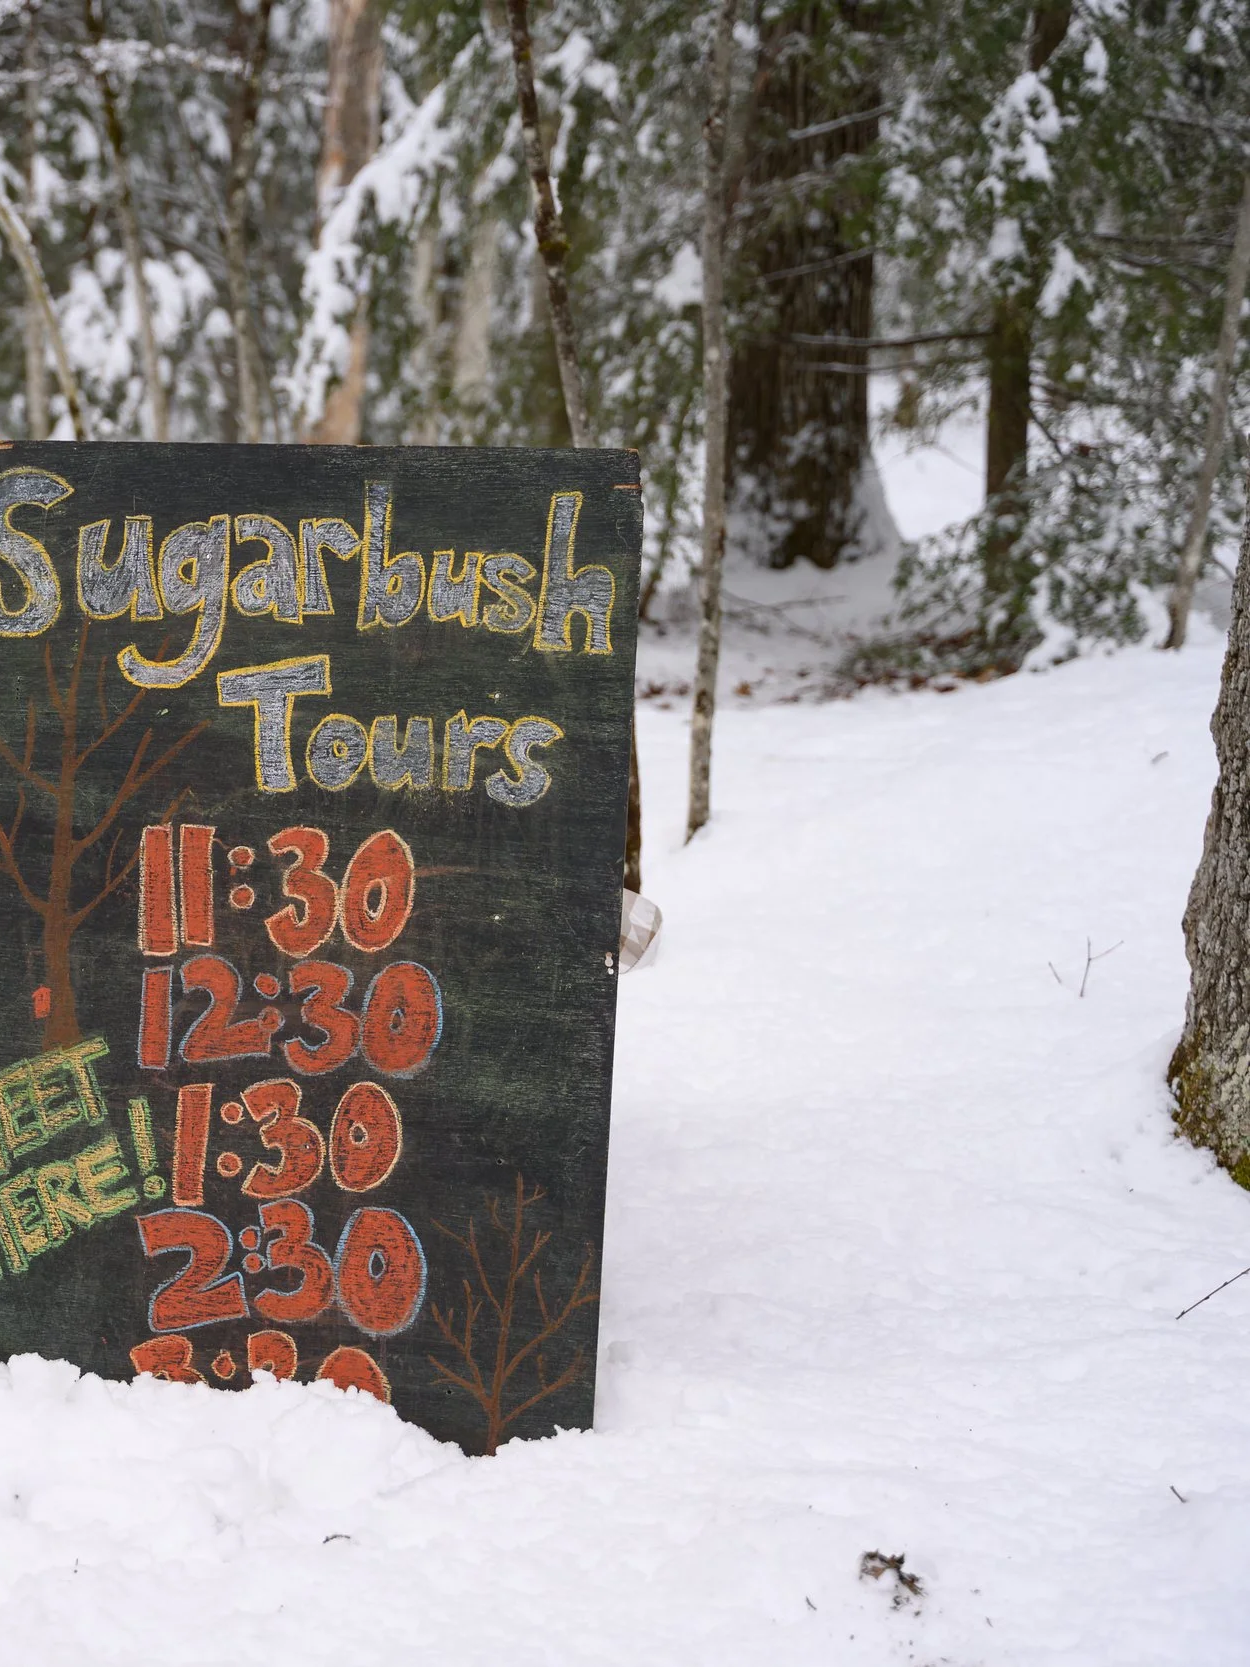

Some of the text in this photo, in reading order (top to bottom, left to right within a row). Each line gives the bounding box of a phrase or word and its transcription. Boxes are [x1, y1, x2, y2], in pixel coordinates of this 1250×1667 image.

[217, 654, 563, 806] Tours
[138, 824, 414, 957] 11:30
[137, 955, 442, 1078] 12:30
[173, 1078, 403, 1206] 1:30
[136, 1199, 427, 1336] 2:30
